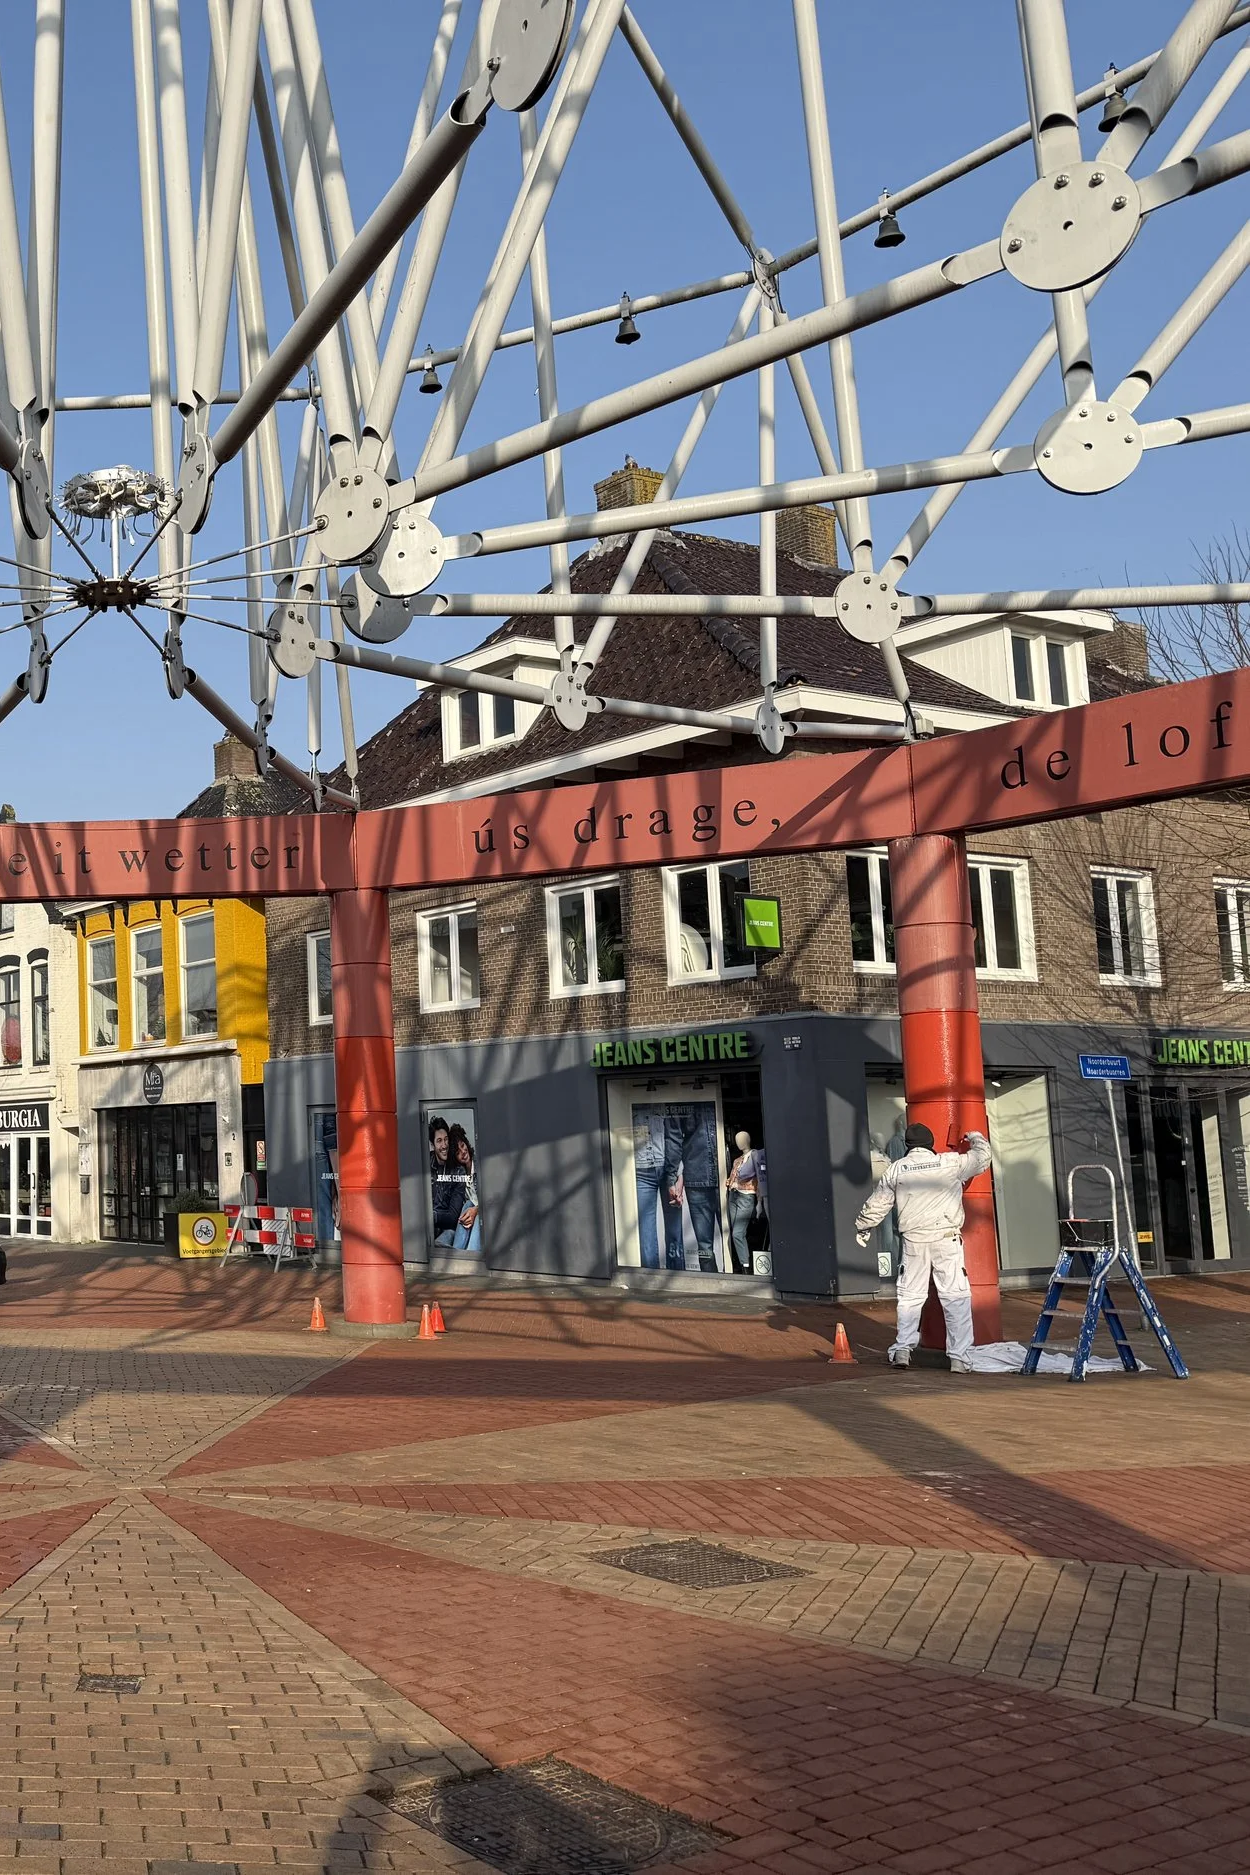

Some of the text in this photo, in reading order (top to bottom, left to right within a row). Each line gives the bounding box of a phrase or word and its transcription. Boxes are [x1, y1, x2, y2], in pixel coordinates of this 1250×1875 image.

[1000, 700, 1233, 790] de lof
[471, 798, 781, 854] ús drage,
[54, 841, 92, 876] it
[118, 842, 301, 873] wetter
[589, 1039, 657, 1067] JEANS
[661, 1031, 752, 1064] CENTRE
[1157, 1039, 1250, 1065] JEANS CENT
